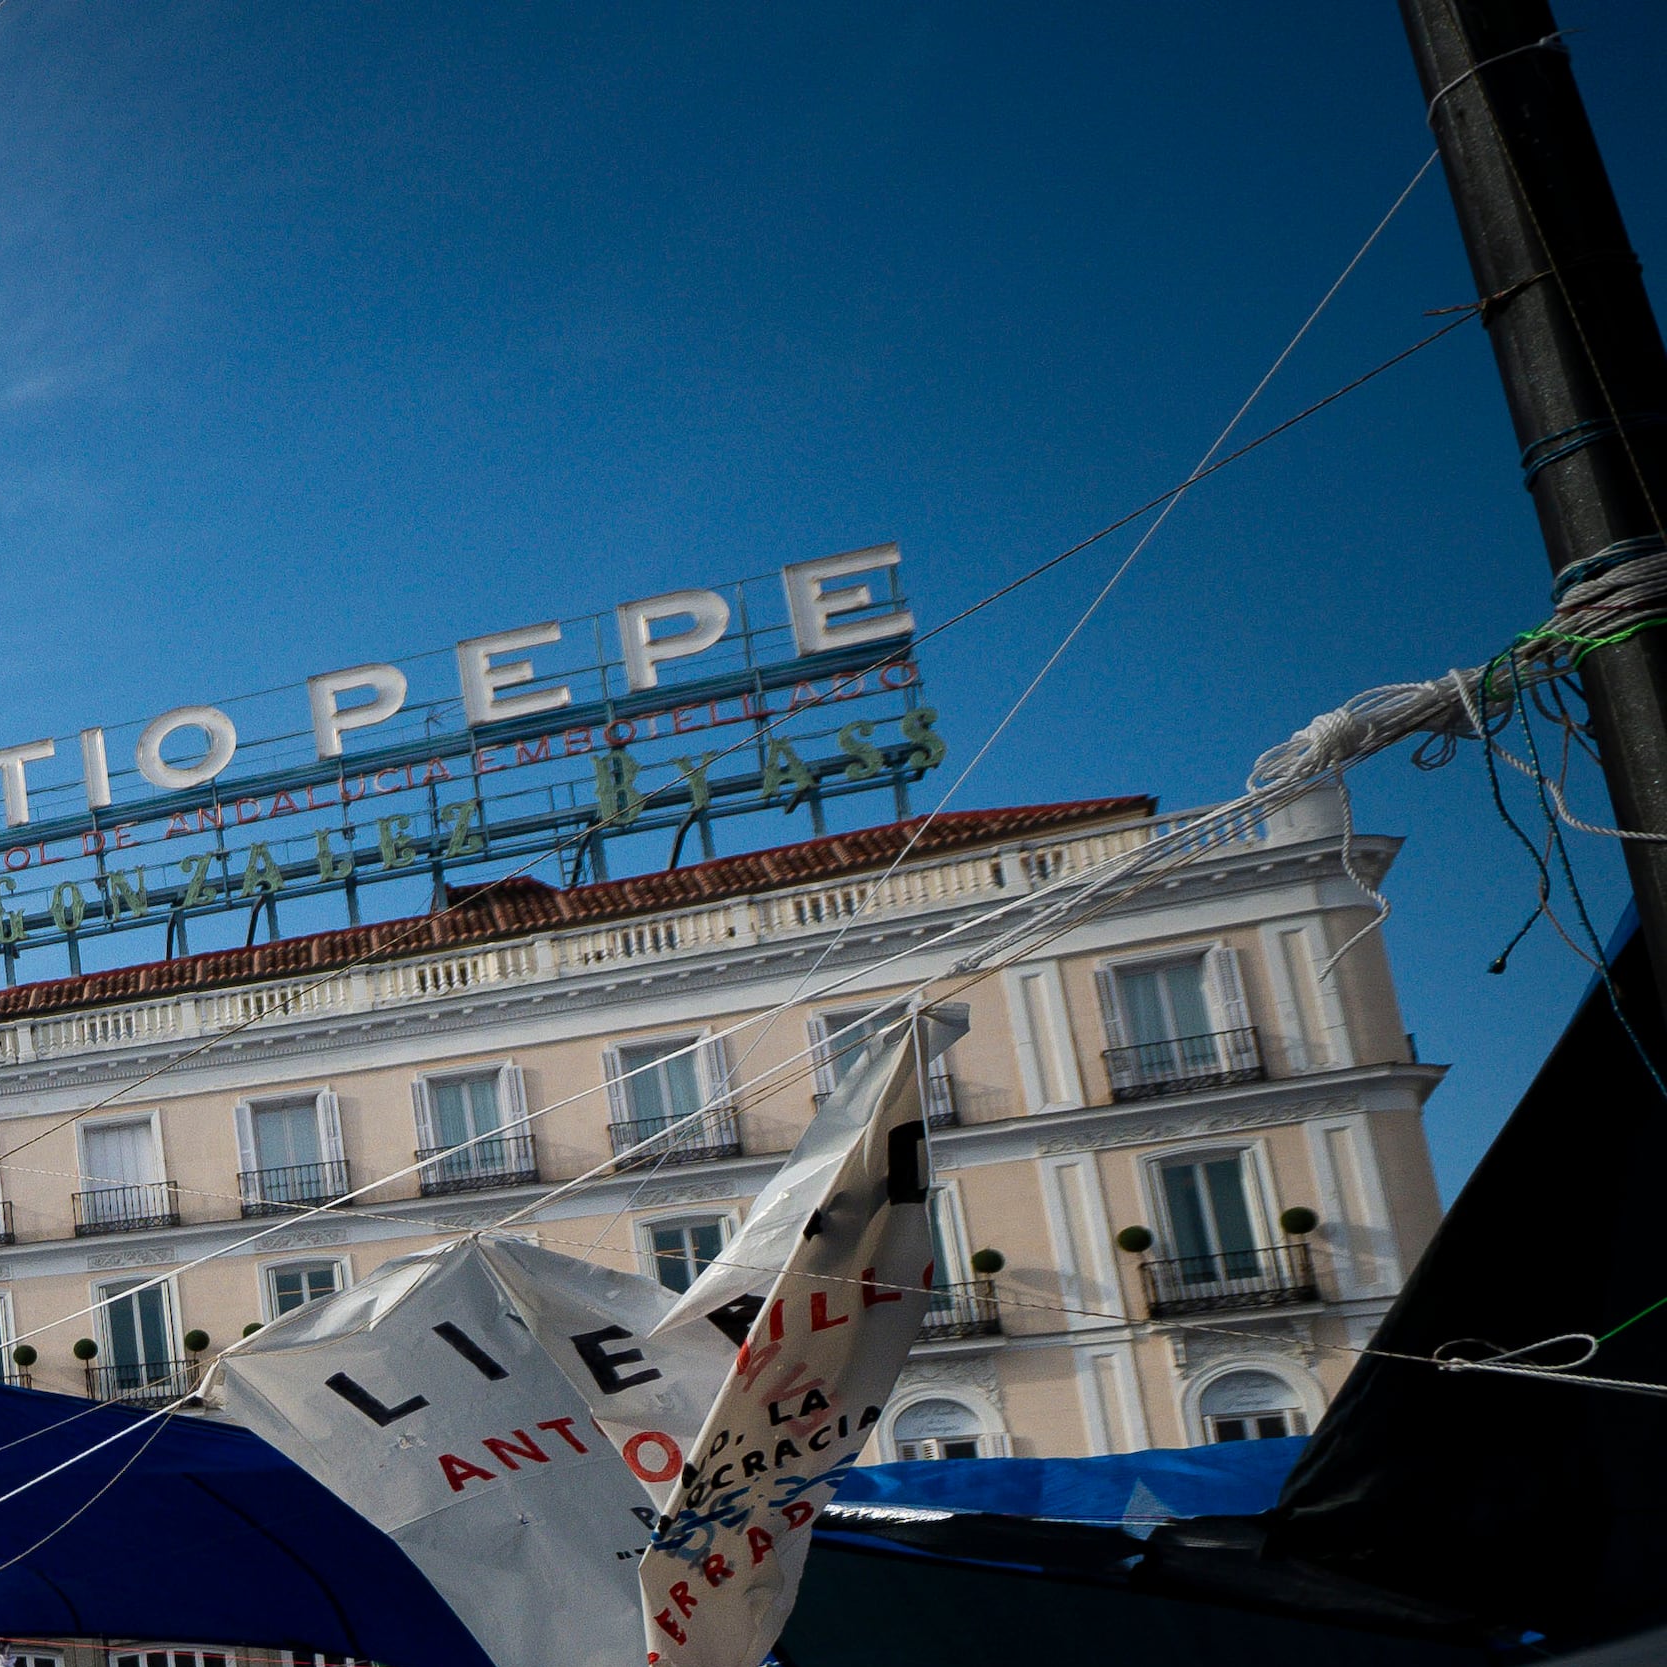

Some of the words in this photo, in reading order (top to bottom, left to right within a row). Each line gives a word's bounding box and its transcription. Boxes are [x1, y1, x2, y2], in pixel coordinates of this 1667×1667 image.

[307, 541, 916, 761] PEPE
[81, 820, 140, 857] DE
[165, 755, 453, 840] ANDALUCIA
[475, 660, 919, 774] EMBOTELLADO
[592, 706, 947, 827] BYASS
